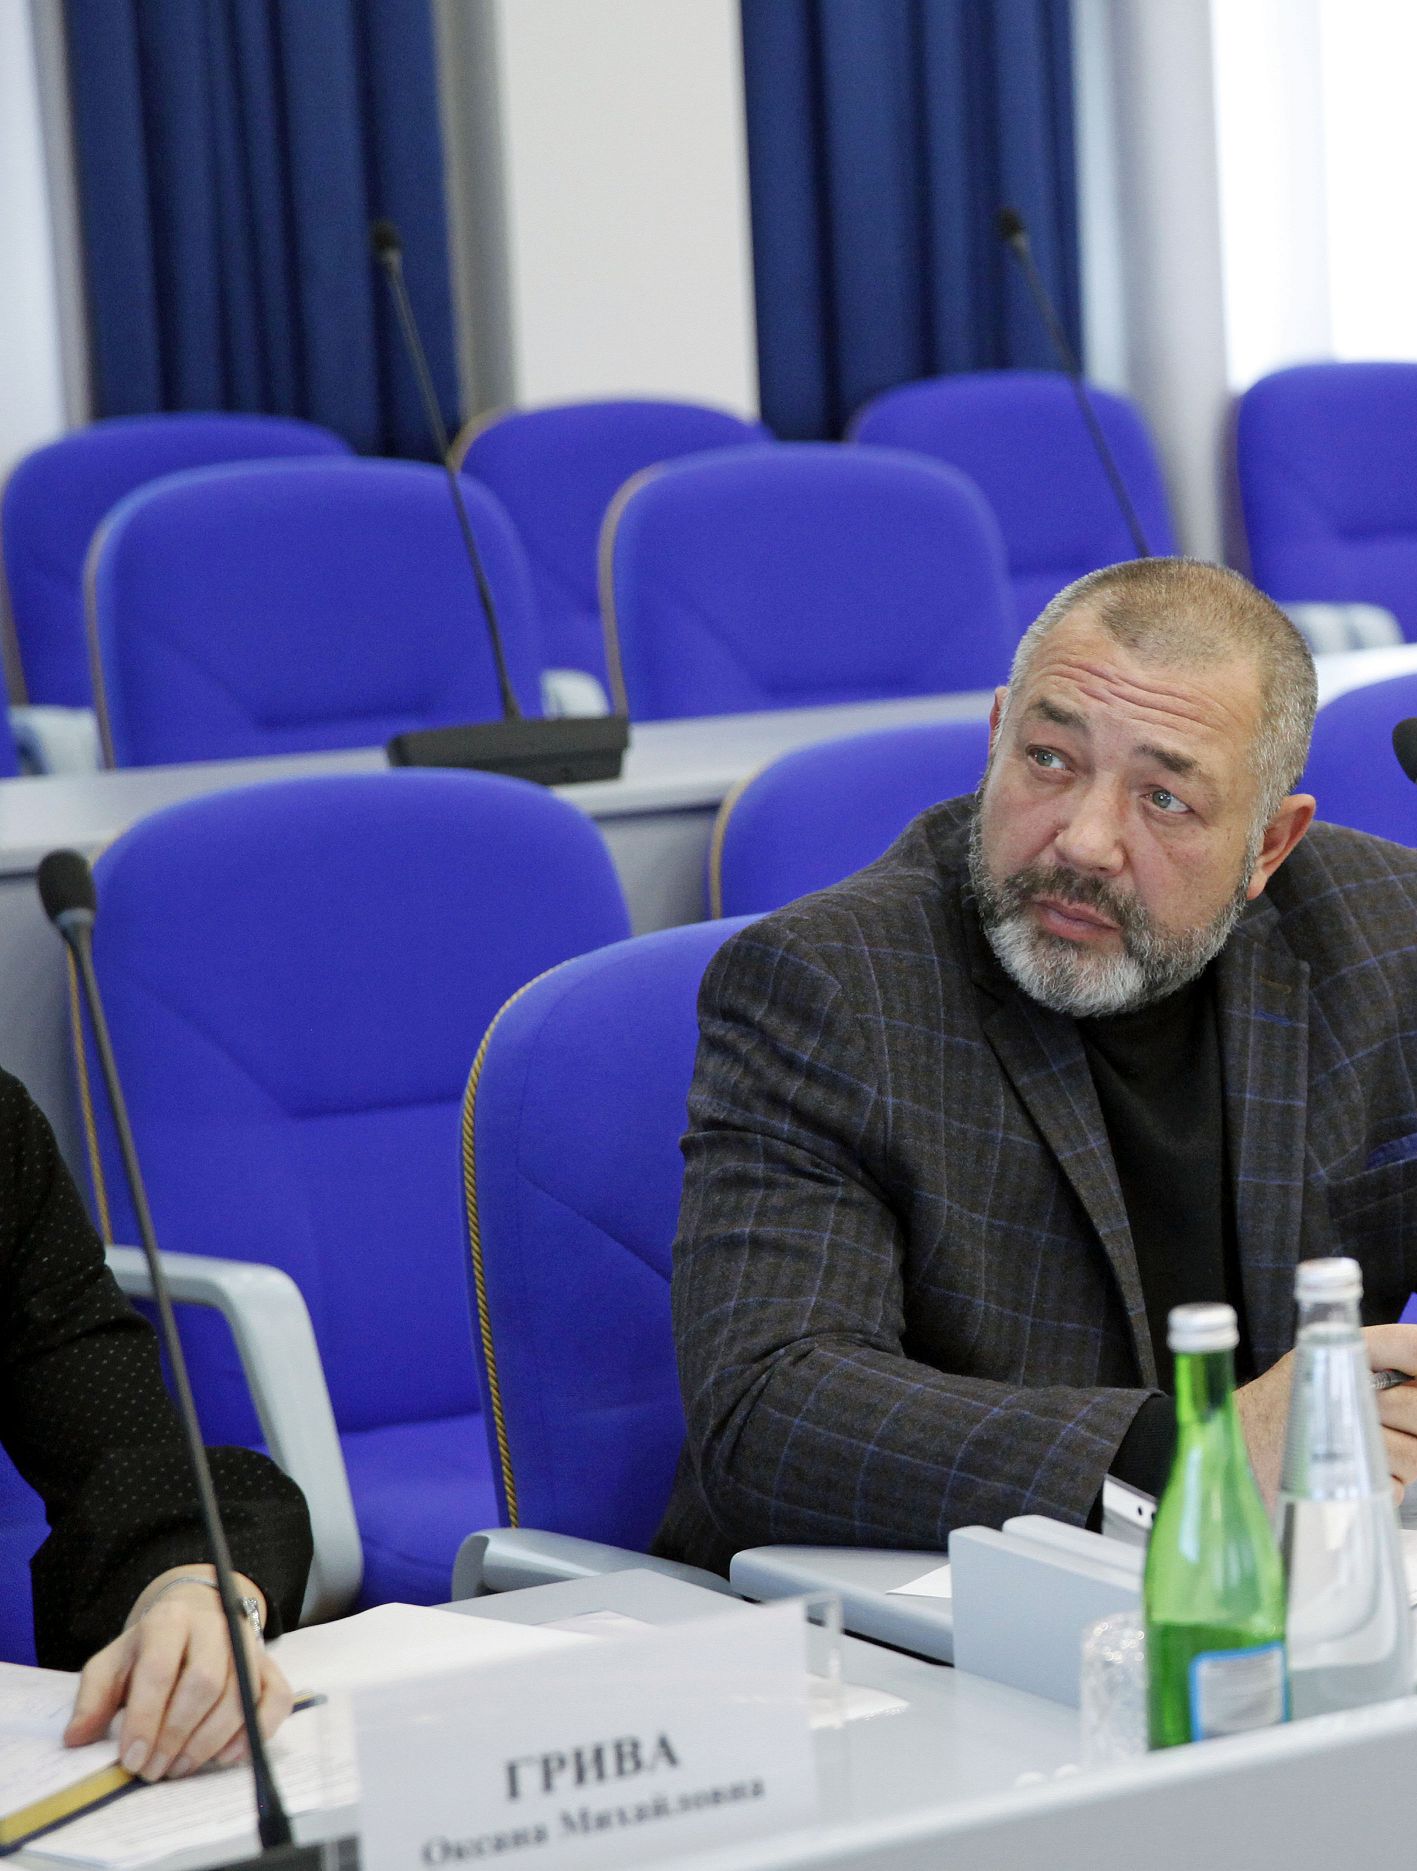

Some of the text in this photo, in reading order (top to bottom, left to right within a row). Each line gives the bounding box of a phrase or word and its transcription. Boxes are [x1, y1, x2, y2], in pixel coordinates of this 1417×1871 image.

[506, 1733, 679, 1800] ГРИВА
[422, 1779, 764, 1867] Оксана Михайловна
